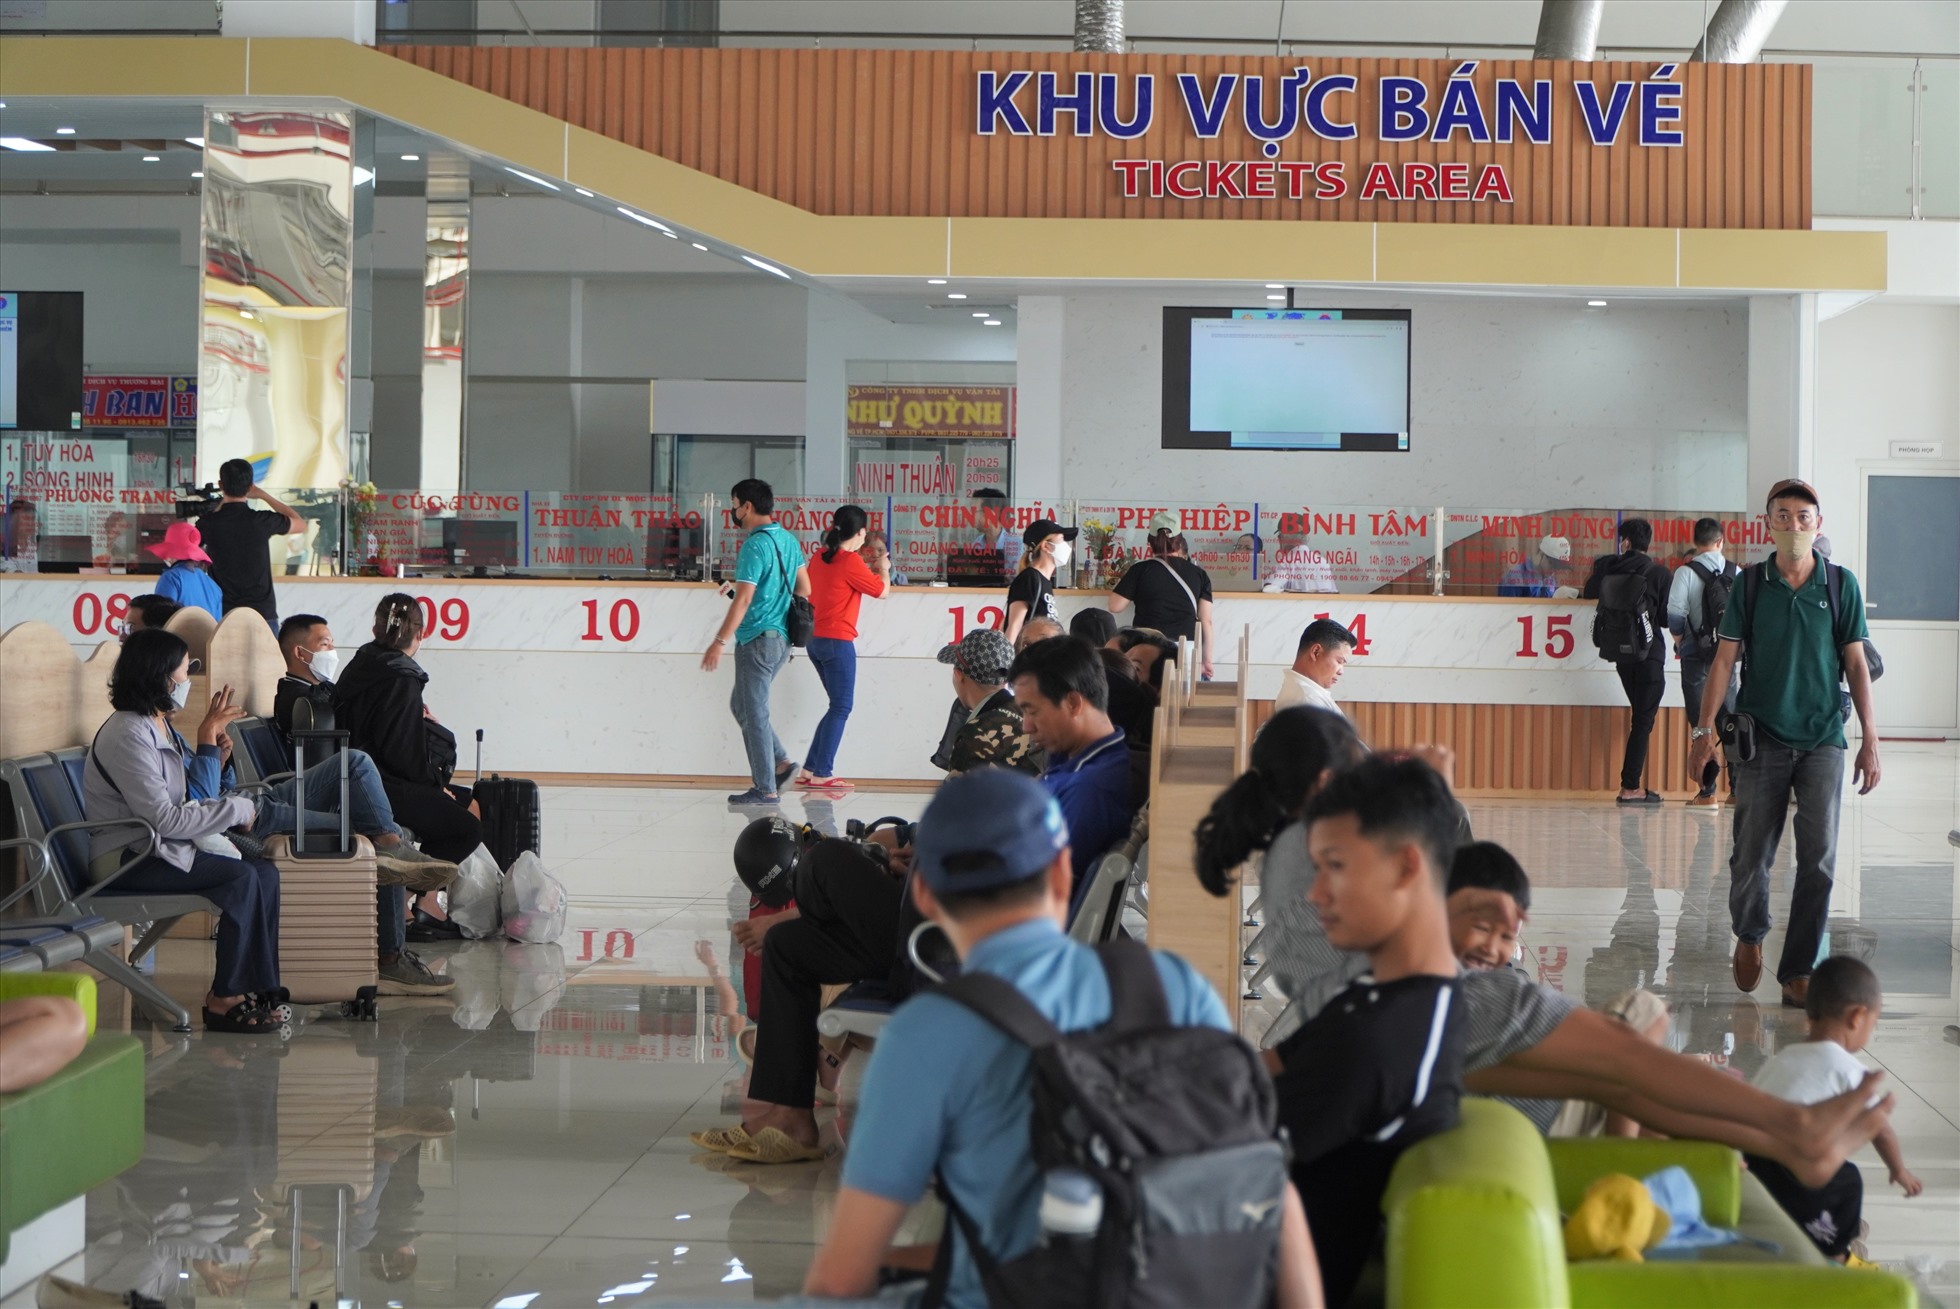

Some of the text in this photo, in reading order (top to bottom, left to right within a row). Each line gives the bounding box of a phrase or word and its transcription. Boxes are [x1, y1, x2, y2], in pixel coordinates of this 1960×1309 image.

[976, 61, 1683, 159] KHU VỰC BÁN VÉ
[1113, 159, 1513, 203] TICKETS AREA
[862, 387, 885, 395] CÔNG
[903, 396, 1003, 428] QUỲNH
[6, 438, 94, 462] 1. TUY HÒA
[1898, 444, 1920, 453] PHÒNG
[966, 457, 999, 468] 20h25
[25, 466, 70, 488] SÔNG
[856, 455, 956, 500] NINH THUẬN
[966, 473, 999, 483] 20h50
[119, 490, 177, 504] TRANG
[452, 491, 520, 512] TÙNG
[534, 504, 701, 532] THUẬN THẢO
[919, 499, 977, 528] CHÍN
[1117, 503, 1251, 537] PH HIỆP
[1281, 506, 1427, 537] BÌNH TÂM
[1481, 513, 1616, 540] MINH DŨNG
[1653, 514, 1776, 545] MIN GHĨA
[547, 546, 575, 564] NAM
[579, 546, 604, 565] TUY
[607, 543, 634, 565] HOÀ
[909, 536, 959, 556] QUẢNG
[1275, 544, 1322, 564] QUẢNG
[1326, 547, 1357, 565] NGÃI
[1274, 571, 1302, 580] PHÒNG
[581, 598, 640, 642] 10
[1516, 614, 1575, 658] 15
